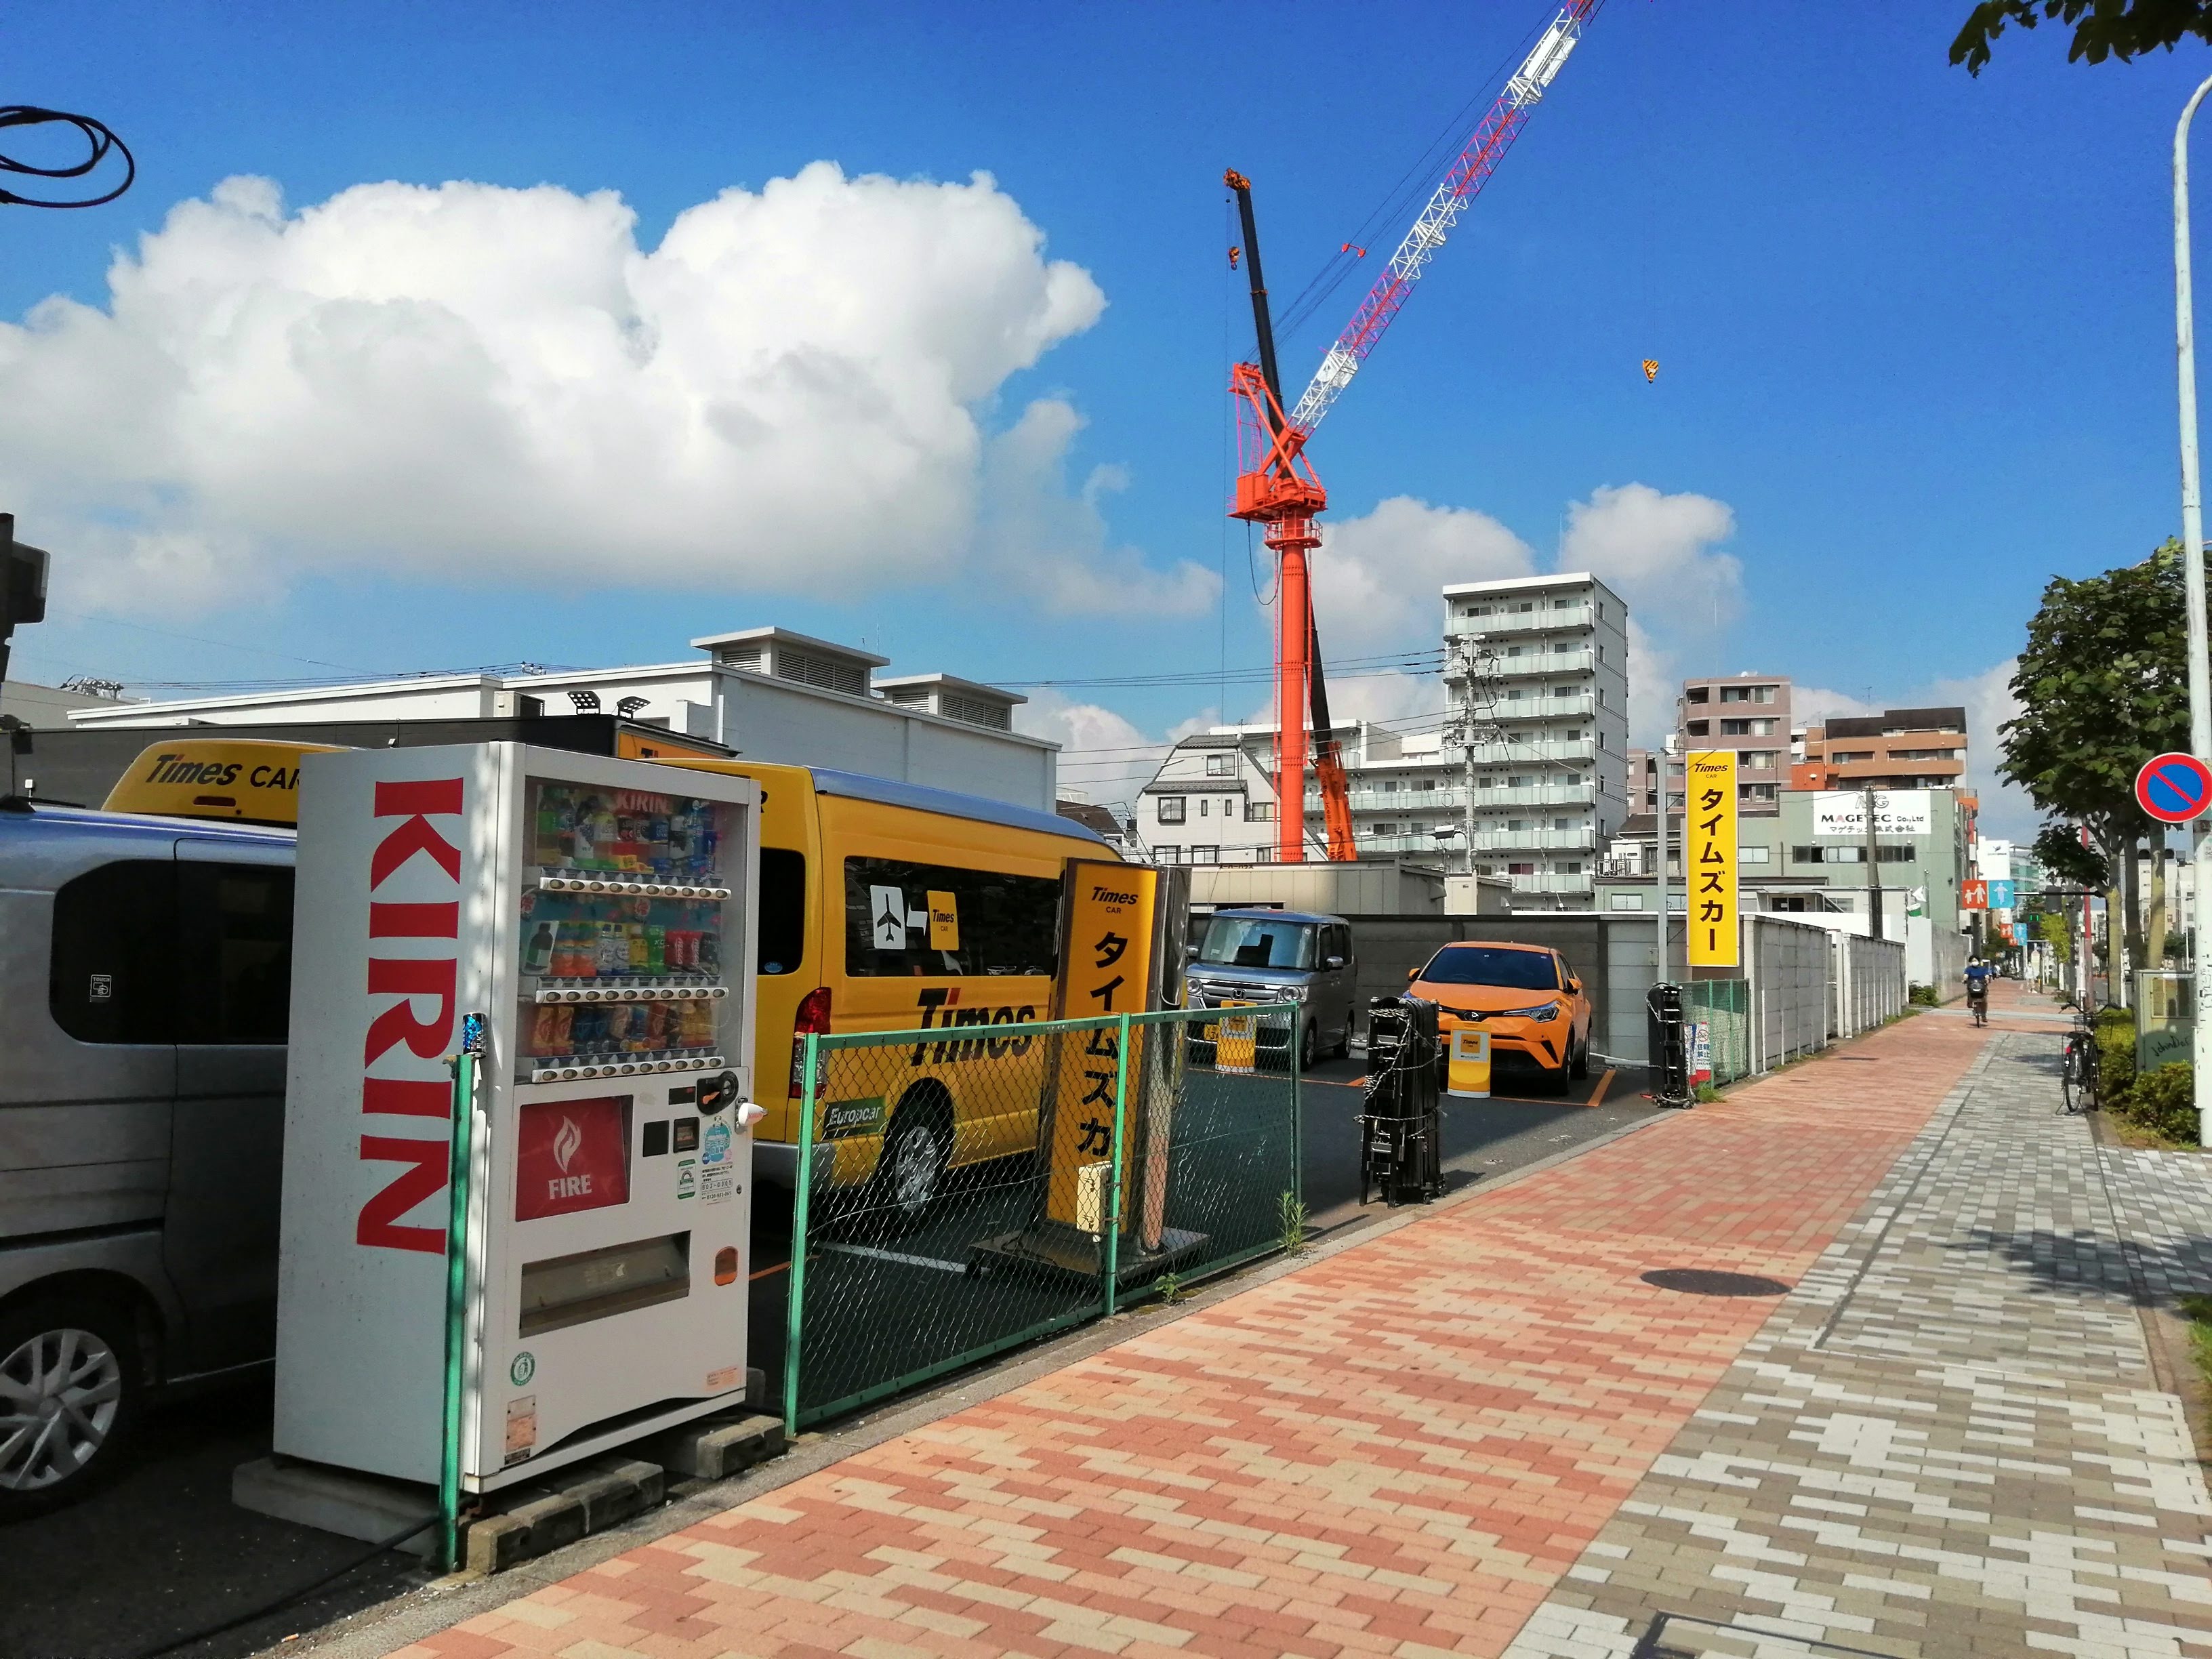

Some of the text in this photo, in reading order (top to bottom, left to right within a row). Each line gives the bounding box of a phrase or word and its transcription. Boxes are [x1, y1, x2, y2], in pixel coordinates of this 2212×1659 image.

[146, 754, 243, 785] Times
[1694, 764, 1728, 773] Times
[617, 792, 668, 813] KIRIN
[1821, 815, 1891, 823] MAGEEC
[1700, 789, 1725, 951] タイムズカー
[1091, 886, 1139, 905] Times
[933, 909, 955, 923] Times
[1106, 906, 1122, 914] CAR
[356, 777, 464, 1255] KIRIN
[911, 987, 1036, 1067] Times
[830, 1106, 882, 1128] Europcar
[548, 1174, 592, 1200] FIRE
